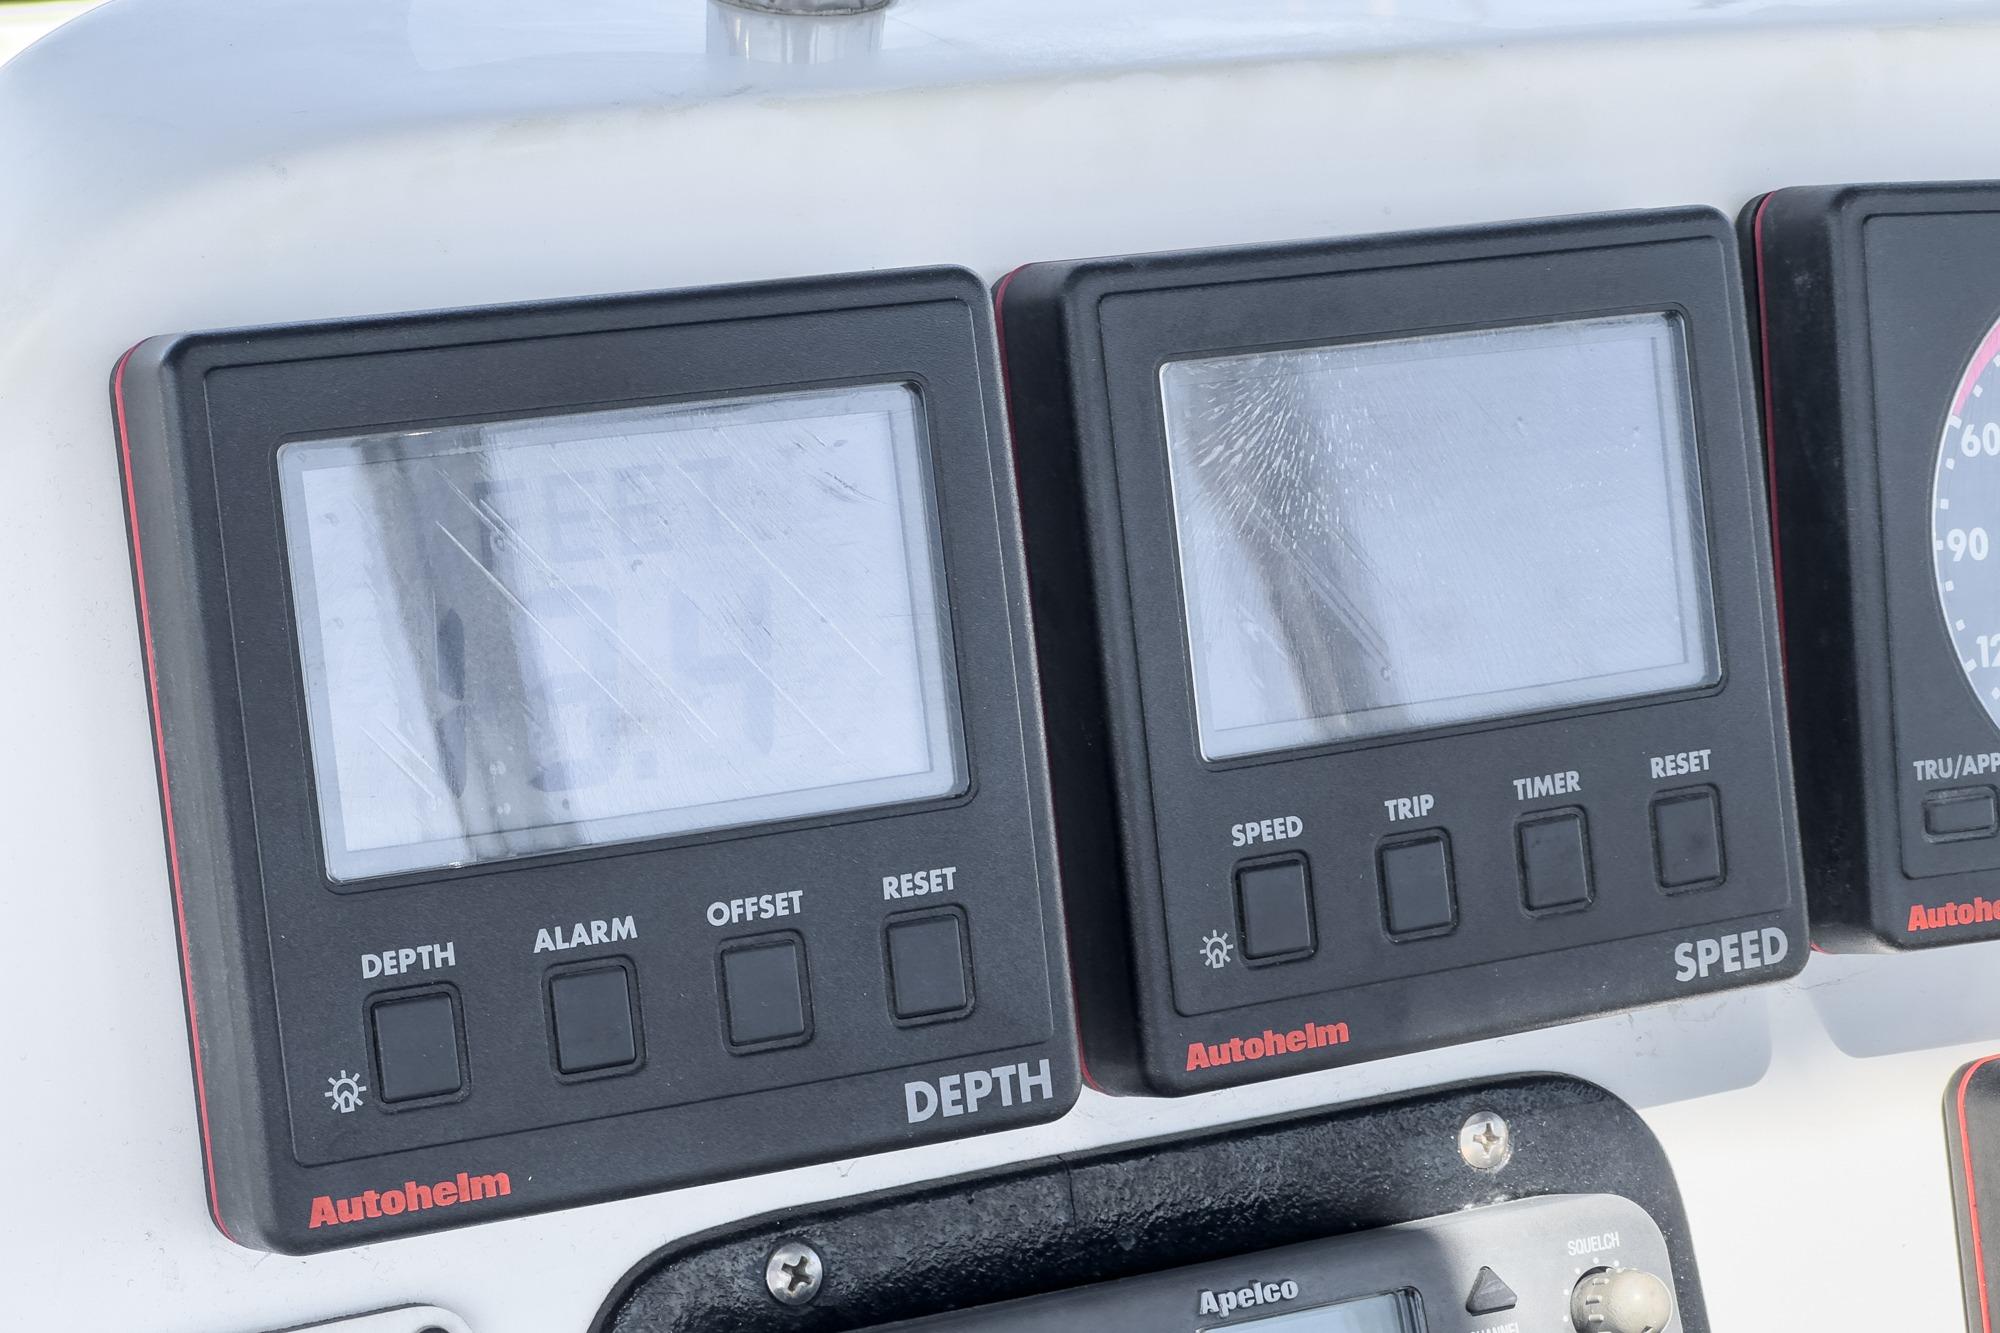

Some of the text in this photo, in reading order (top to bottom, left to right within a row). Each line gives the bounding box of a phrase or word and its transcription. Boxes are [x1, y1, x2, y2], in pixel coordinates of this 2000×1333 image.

[1946, 527, 1989, 562] 90
[1650, 749, 1711, 778] RESET
[1513, 771, 1581, 800] TIMER
[1384, 794, 1434, 821] TRIP
[1232, 816, 1303, 846] SPEED
[883, 867, 956, 900] RESET
[707, 890, 803, 926] OFFSET
[534, 916, 637, 953] ALARM
[362, 942, 455, 979] DEPTH
[1675, 927, 1788, 982] SPEED
[1186, 1022, 1349, 1071] Autohelm
[905, 1059, 1053, 1124] DEPTH
[310, 1172, 511, 1229] Autohelm
[1567, 1231, 1621, 1256] SQUELCH
[1201, 1280, 1299, 1318] Apelco
